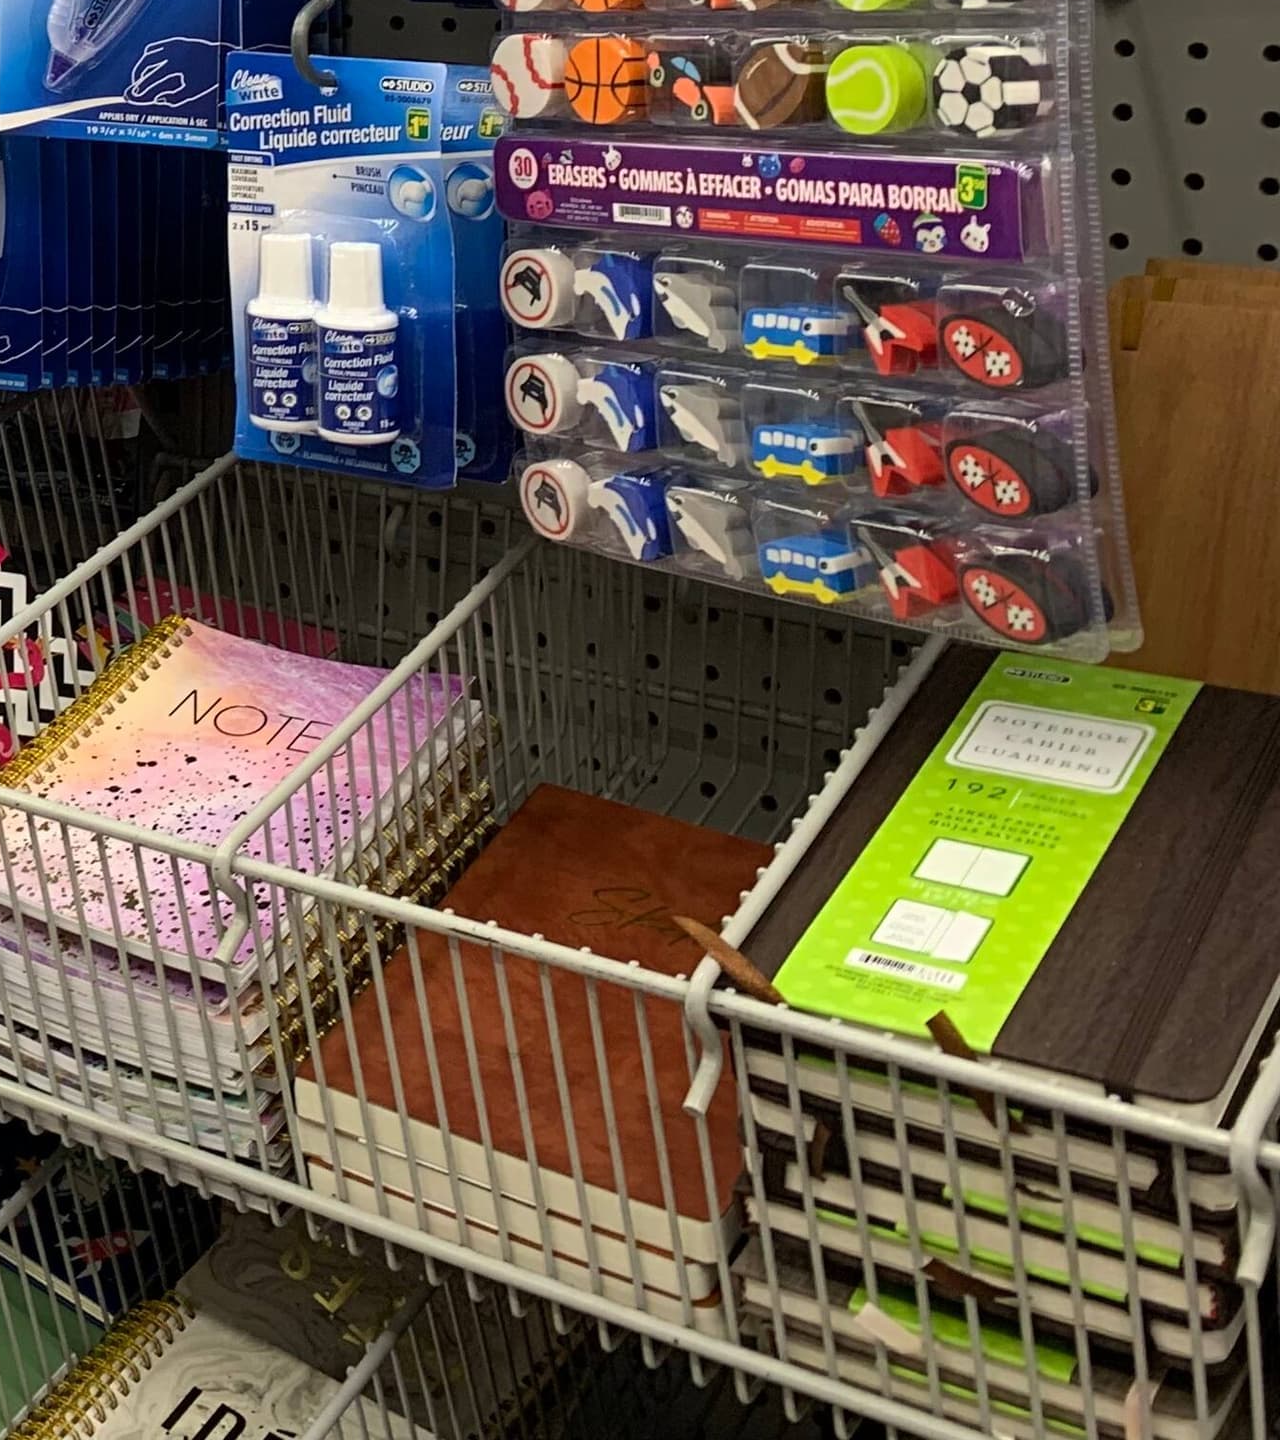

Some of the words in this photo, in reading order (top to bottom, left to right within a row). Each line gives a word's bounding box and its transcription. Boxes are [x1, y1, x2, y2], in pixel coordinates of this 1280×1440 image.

[396, 80, 432, 92] STUDIO
[230, 108, 310, 132] Correction
[314, 103, 352, 124] Fluid
[260, 127, 317, 152] Liquide
[321, 123, 402, 146] correcteur
[356, 165, 382, 177] BRUSH
[515, 155, 532, 177] 30
[548, 164, 606, 188] ERASERS
[619, 168, 683, 194] GOMMES
[699, 172, 761, 200] EFFACER
[775, 178, 835, 205] GOMAS
[838, 182, 883, 208] PARA
[888, 185, 963, 213] BORRAR
[169, 688, 350, 758] NOTE
[993, 714, 1130, 745] NOTEBOOK
[1007, 732, 1098, 756] CAHIER
[974, 745, 1112, 776] CUADERNO
[946, 777, 1008, 801] 192
